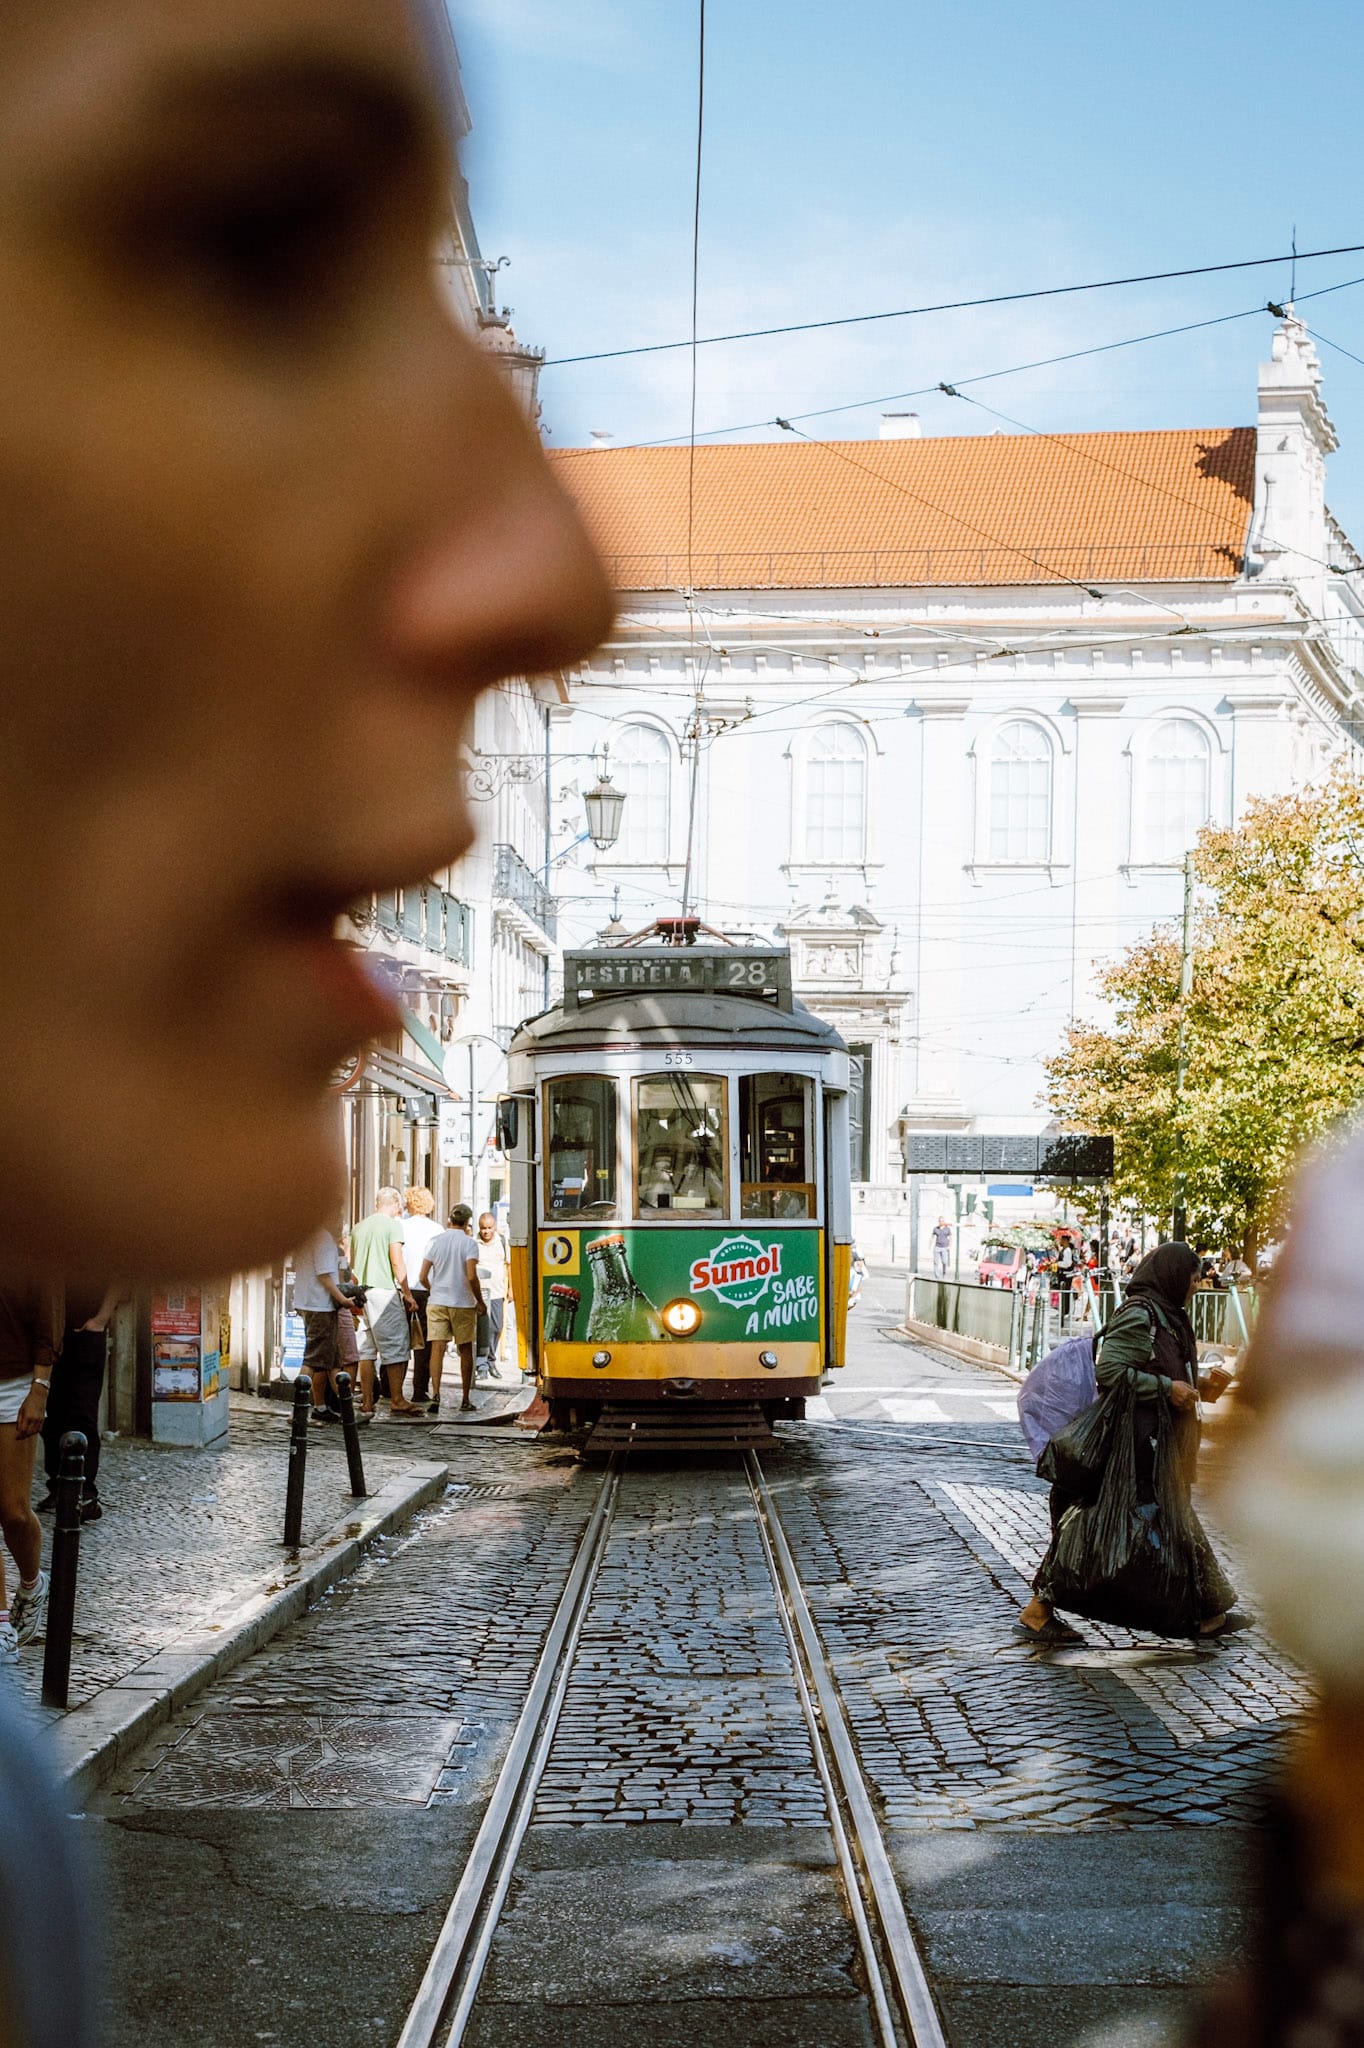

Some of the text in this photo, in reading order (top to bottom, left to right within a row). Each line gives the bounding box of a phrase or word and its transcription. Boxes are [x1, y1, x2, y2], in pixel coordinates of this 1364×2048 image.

[585, 962, 766, 986] ESTRELA 28
[665, 1053, 693, 1065] 555
[553, 1199, 564, 1208] 01
[693, 1247, 778, 1290] Sumol
[772, 1275, 815, 1304] SABE
[745, 1296, 818, 1335] A MUITO
